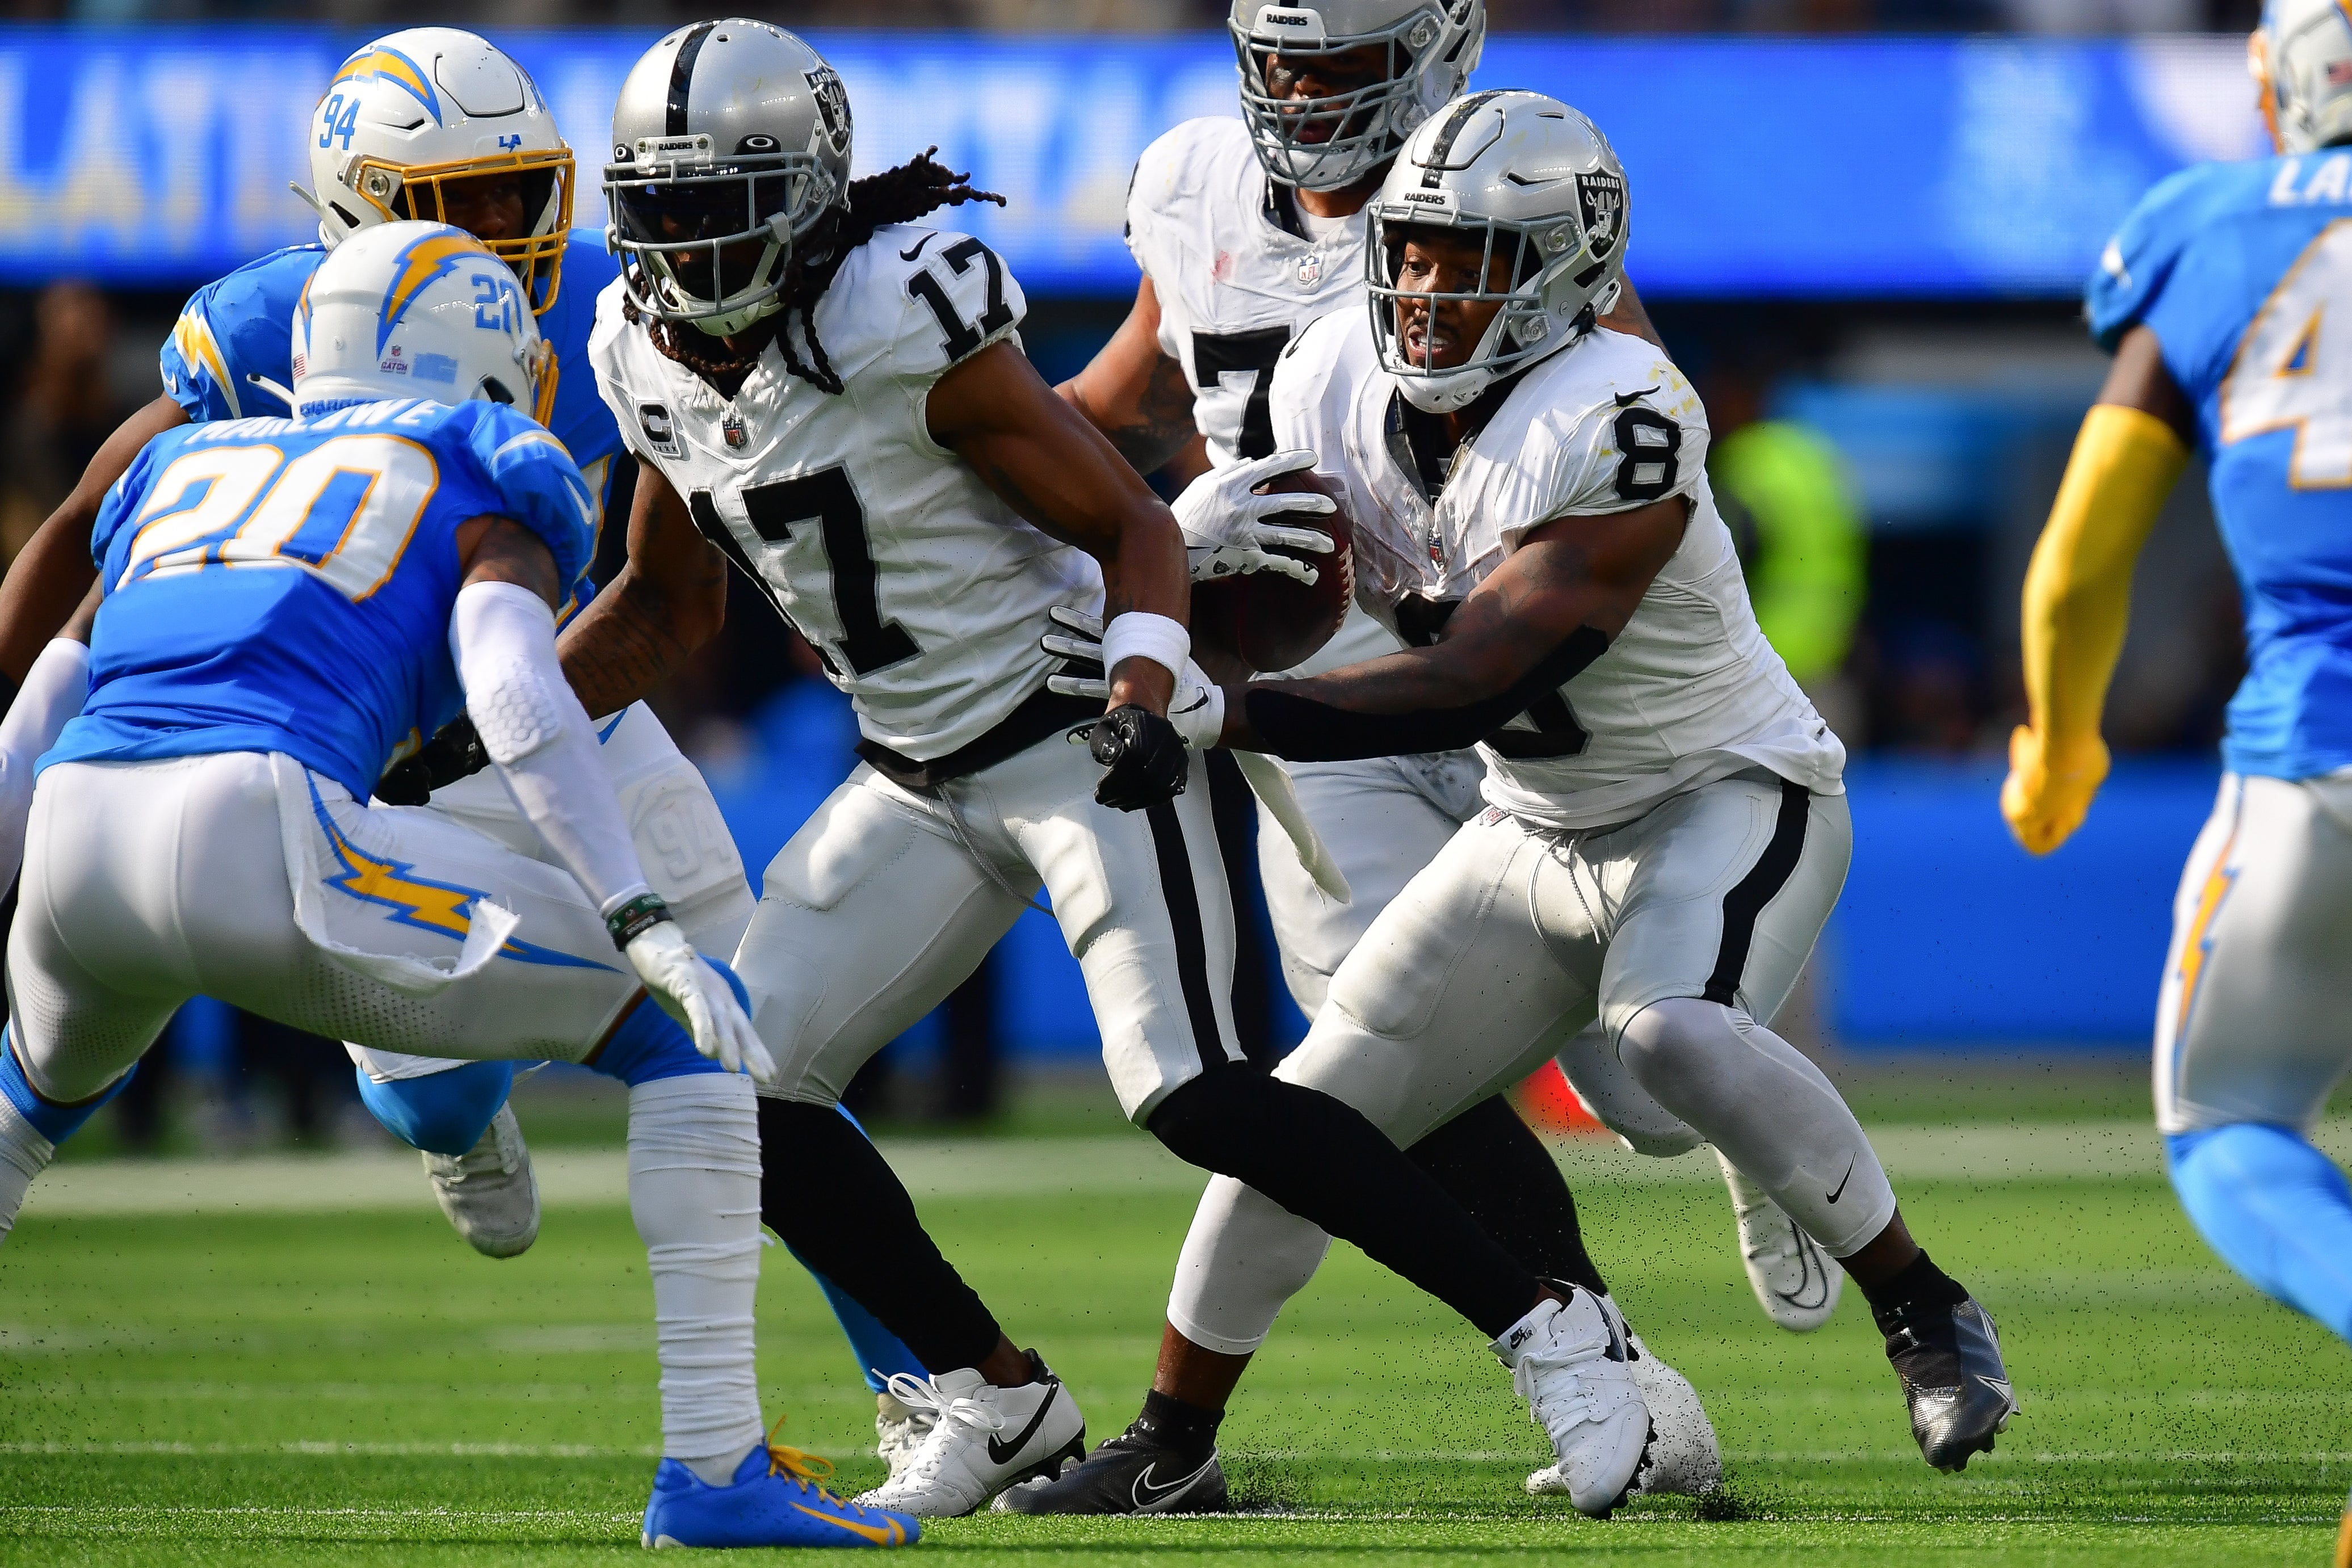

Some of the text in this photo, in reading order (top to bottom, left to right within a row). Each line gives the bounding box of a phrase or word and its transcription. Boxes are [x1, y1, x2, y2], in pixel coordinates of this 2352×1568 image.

[1266, 14, 1308, 26] RAIDERS
[320, 94, 361, 150] 94
[658, 141, 693, 151] RAIDERS
[1404, 193, 1446, 205] RAIDERS
[1582, 176, 1619, 188] RAIDERS
[2269, 154, 2352, 207] LA
[472, 273, 522, 335] 20
[905, 236, 1014, 363] 17
[639, 403, 672, 443] C
[726, 430, 744, 444] NFL
[1612, 406, 1683, 501] 8
[115, 434, 440, 603] 20
[1524, 1329, 1534, 1343] AIR
